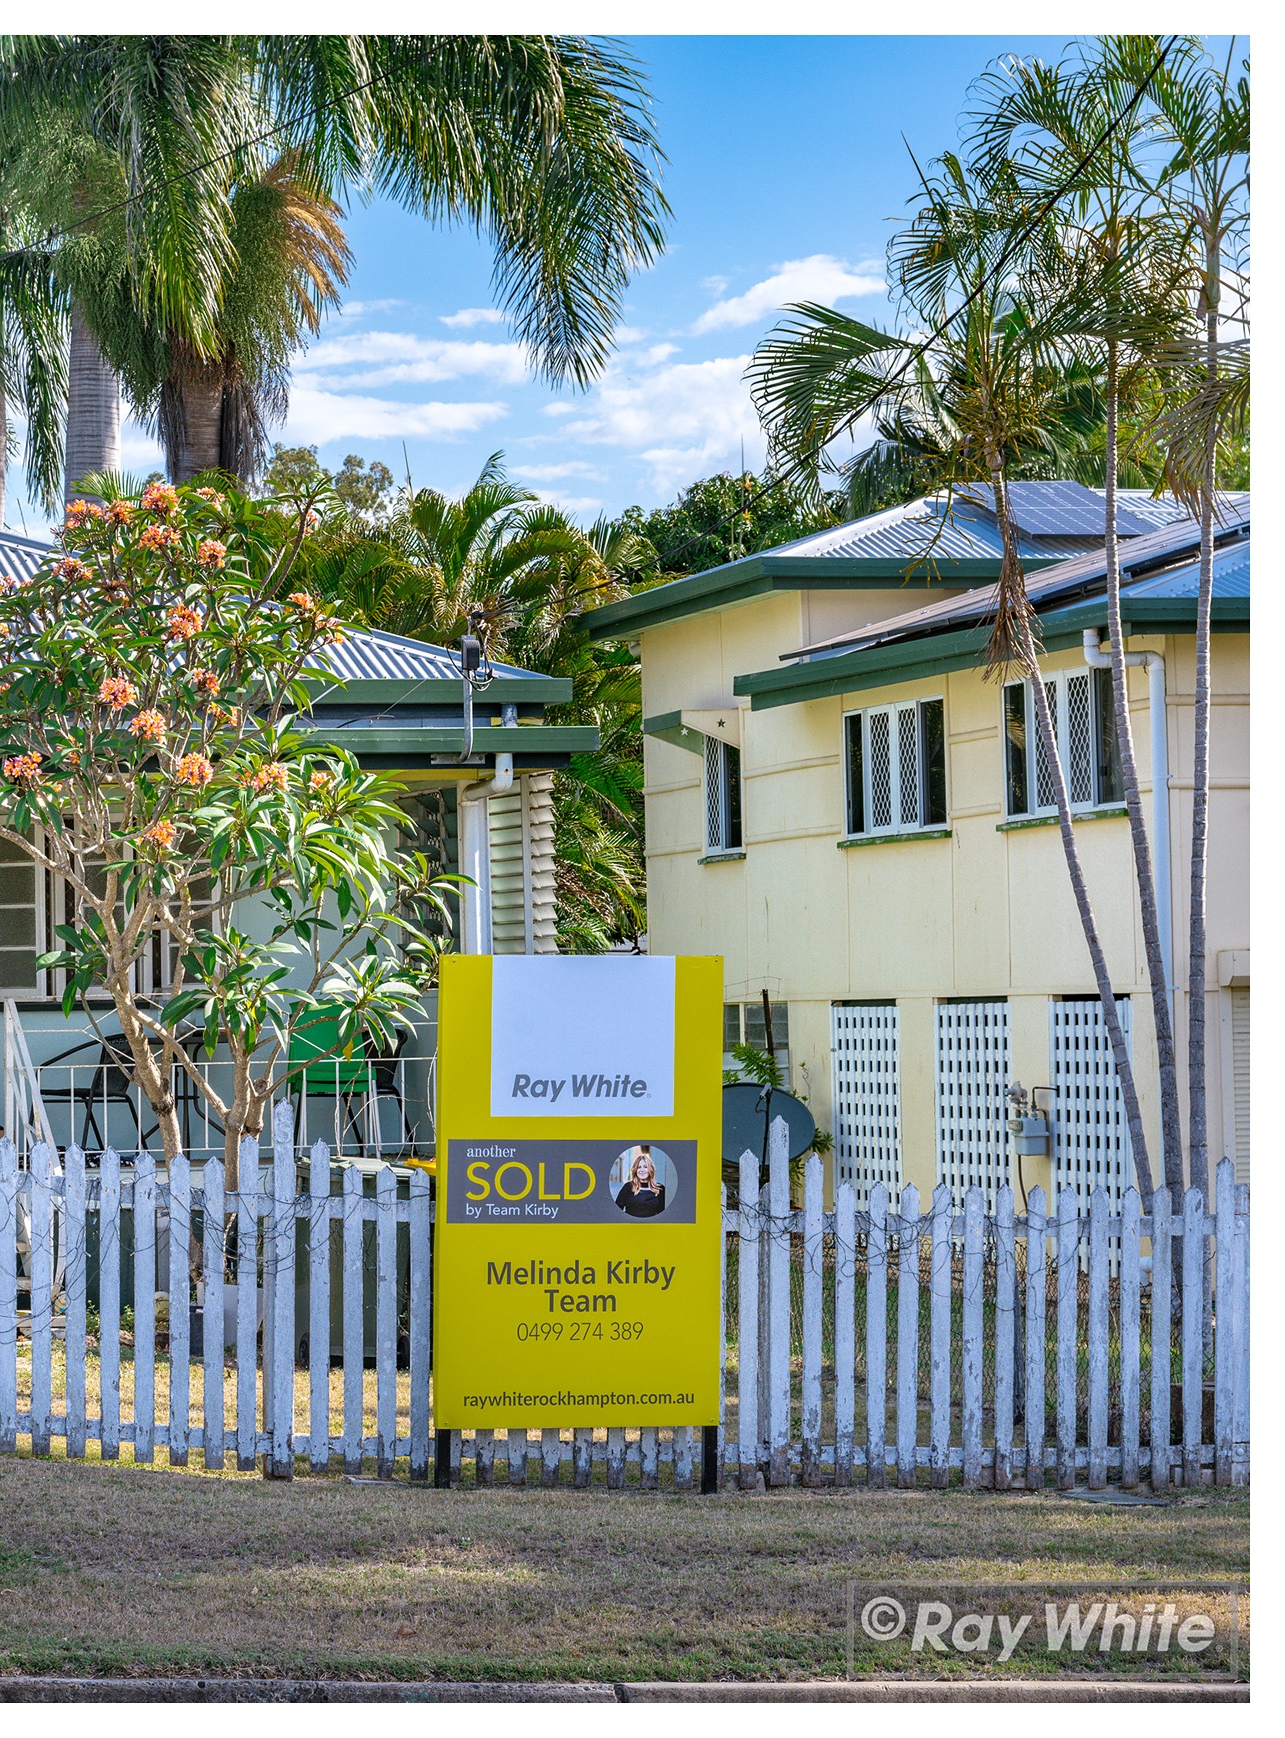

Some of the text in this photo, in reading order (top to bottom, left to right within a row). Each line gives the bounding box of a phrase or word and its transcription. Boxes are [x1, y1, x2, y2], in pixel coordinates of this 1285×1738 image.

[512, 1074, 648, 1102] Ray White
[466, 1145, 516, 1158] another
[465, 1161, 596, 1200] SOLD
[465, 1203, 559, 1219] by Team Kirby
[486, 1259, 676, 1290] Melinda Kirby
[544, 1289, 617, 1313] Team
[517, 1321, 644, 1342] 0499 274 389
[463, 1391, 695, 1410] raywhiterockhampton.com.au
